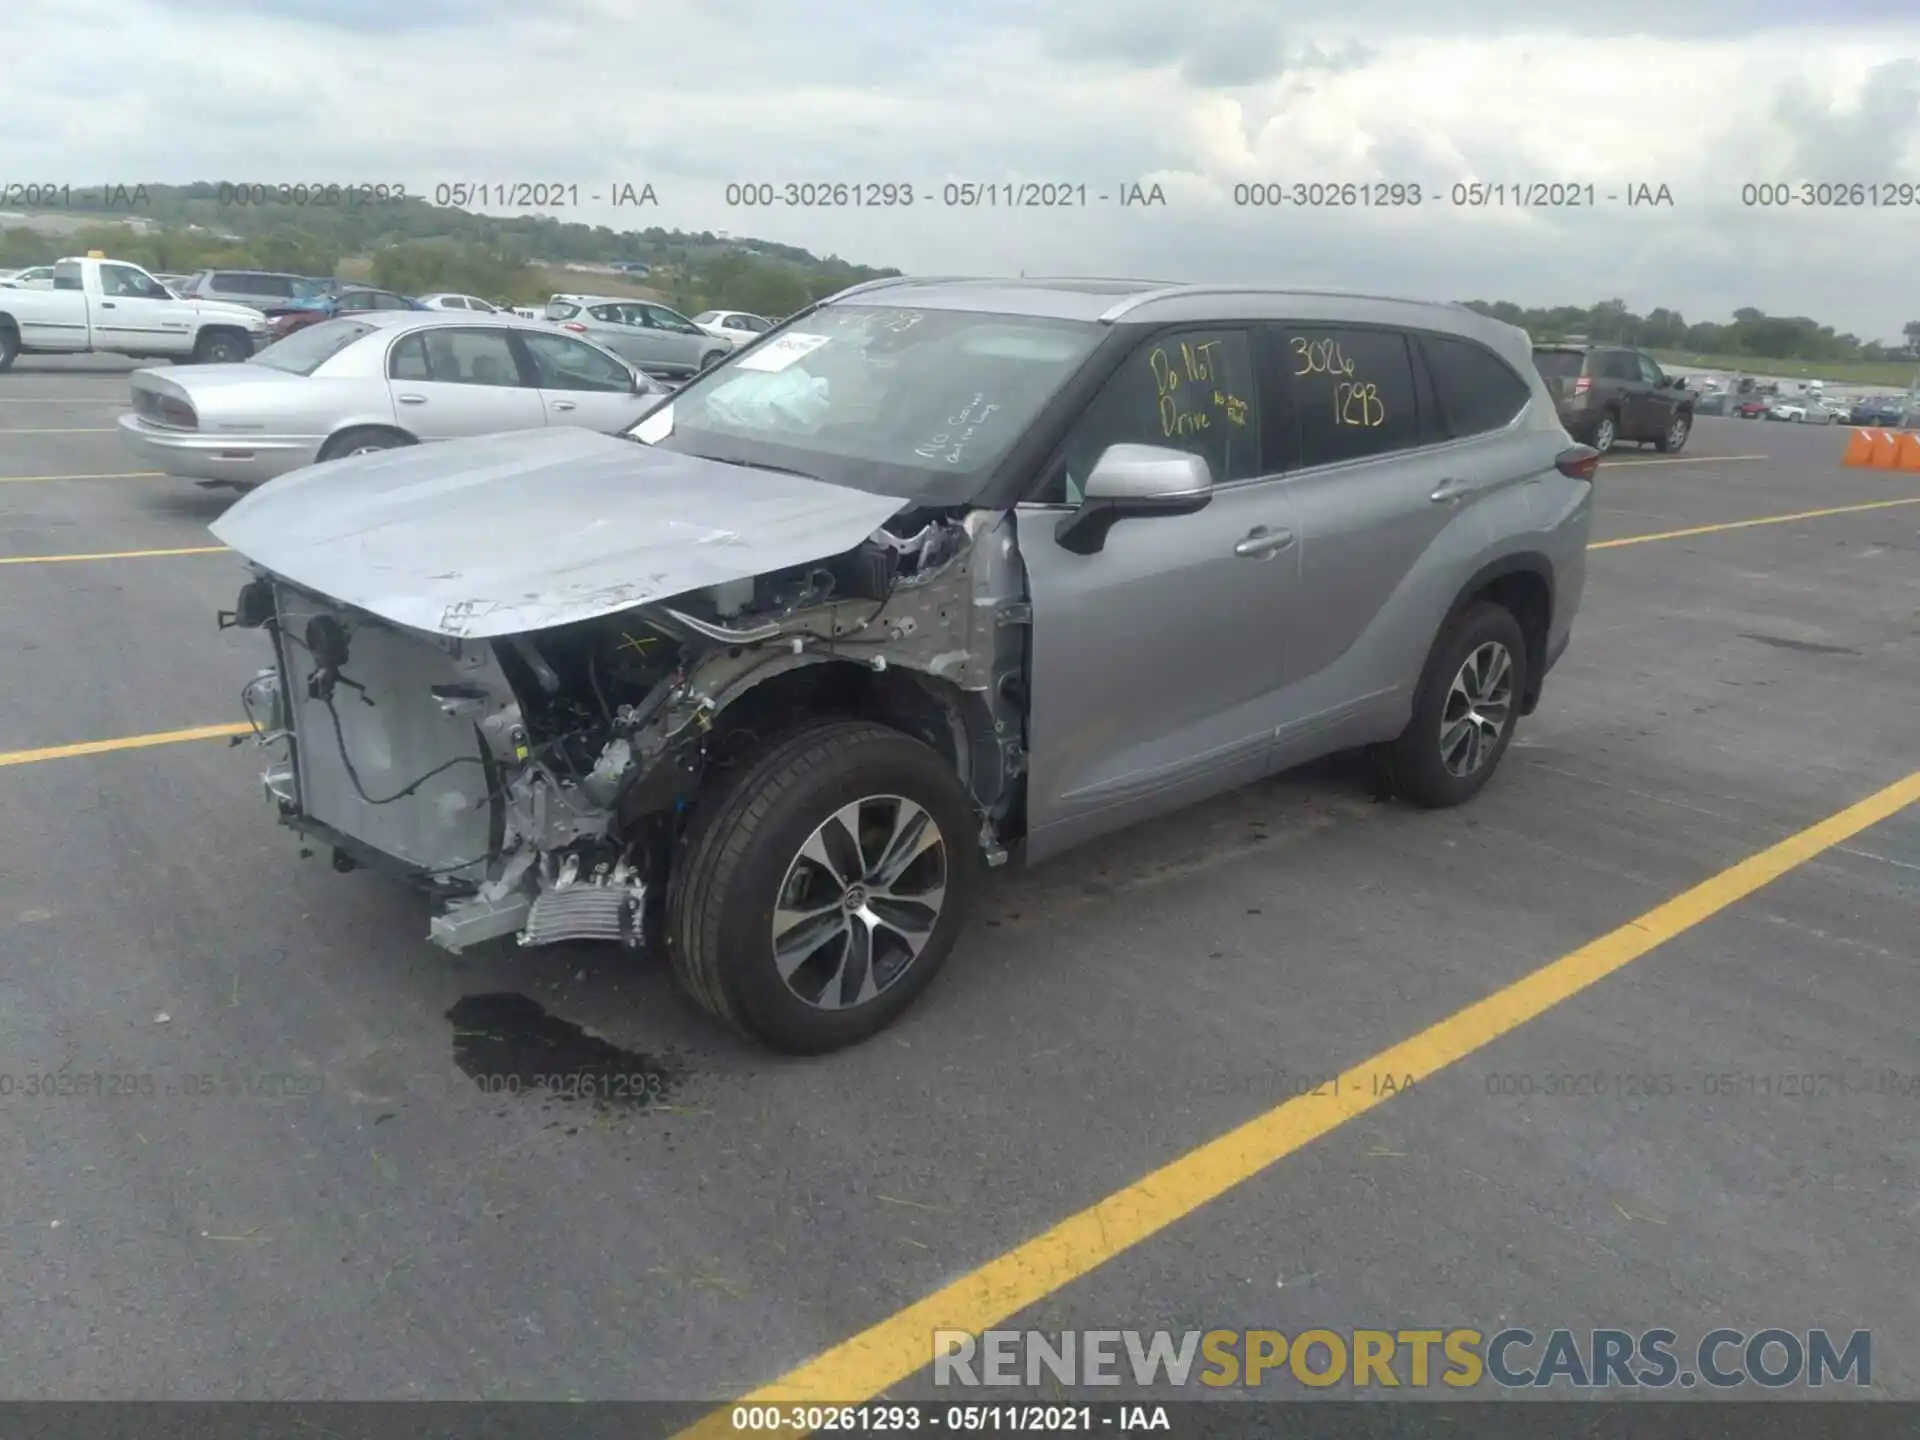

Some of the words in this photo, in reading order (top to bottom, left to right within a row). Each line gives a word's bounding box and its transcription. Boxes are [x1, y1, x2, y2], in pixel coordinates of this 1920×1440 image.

[1149, 347, 1178, 396] Do
[1290, 336, 1355, 377] 3026
[1160, 394, 1211, 437] Drive
[1334, 381, 1385, 427] 1293
